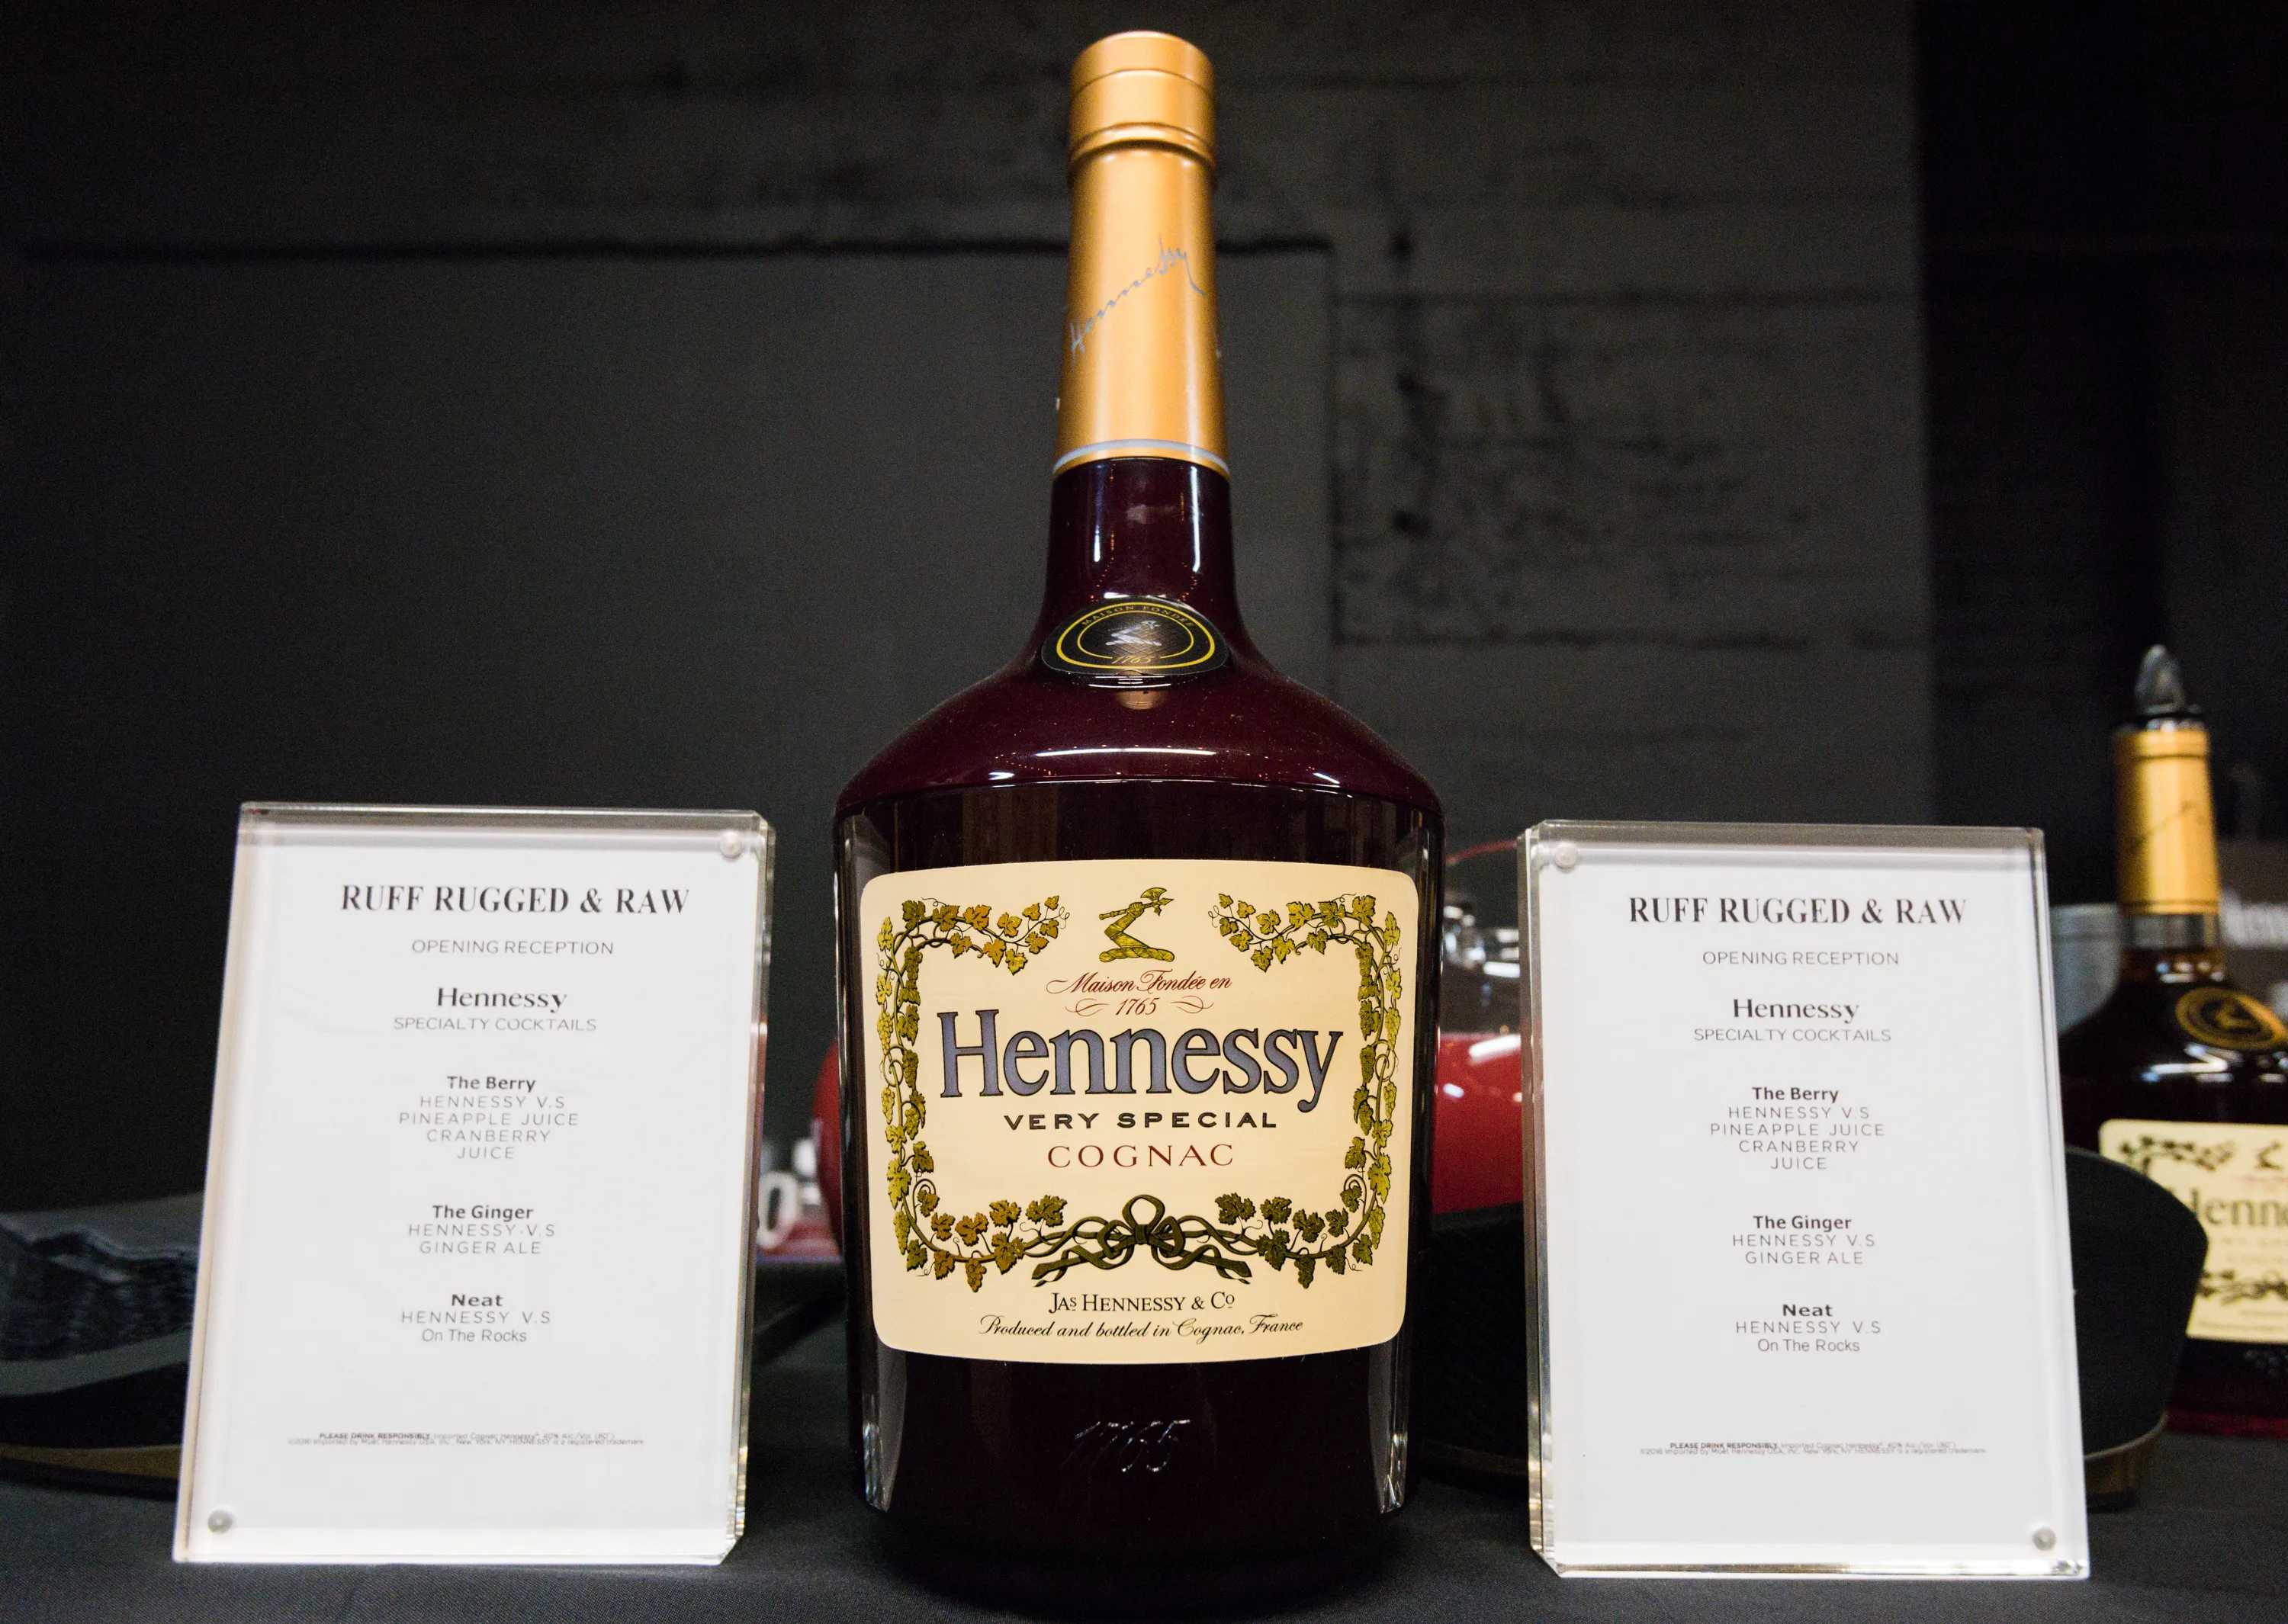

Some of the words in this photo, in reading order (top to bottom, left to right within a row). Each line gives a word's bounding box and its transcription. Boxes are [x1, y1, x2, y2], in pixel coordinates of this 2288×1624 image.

[1081, 605, 1135, 626] MAISON
[1111, 655, 1155, 665] 1765
[342, 885, 424, 911] RUFF
[435, 886, 569, 913] RUGGED
[580, 887, 602, 913] &
[615, 888, 689, 914] RAW
[1629, 897, 1708, 923] RUFF
[1719, 897, 1850, 923] RUGGED
[1861, 898, 1883, 924] &
[1895, 898, 1968, 925] RAW
[411, 939, 499, 954] OPENING
[504, 940, 614, 955] RECEPTION
[1702, 951, 1787, 965] OPENING
[1792, 951, 1899, 965] RECEPTION
[1046, 972, 1136, 993] Maison
[1136, 969, 1206, 993] Fondée
[1210, 978, 1232, 989] en
[437, 987, 567, 1013] Hennessy
[1115, 997, 1158, 1016] 1765
[1733, 998, 1859, 1025] Hennessy
[394, 1017, 490, 1030] SPECIALTY
[495, 1017, 597, 1032] COCKTAILS
[1694, 1029, 1786, 1041] SPECIALTY
[1792, 1029, 1892, 1042] COCKTAILS
[937, 1009, 1344, 1113] Hennessy
[446, 1075, 480, 1090] The
[486, 1076, 536, 1093] Berry
[419, 1095, 527, 1109] HENNESSY
[1751, 1086, 1785, 1101] The
[1790, 1086, 1839, 1104] Berry
[399, 1112, 511, 1126] PINEAPPLE
[521, 1112, 578, 1126] JUICE
[1728, 1106, 1831, 1119] HENNESSY
[1004, 1113, 1099, 1130] VERY
[1117, 1112, 1276, 1128] SPECIAL
[426, 1128, 551, 1143] CRANBERRY
[1710, 1123, 1819, 1136] PINEAPPLE
[1829, 1123, 1885, 1137] JUICE
[457, 1146, 514, 1160] JUICE
[1738, 1140, 1859, 1153] CRANBERRY
[1048, 1144, 1232, 1167] COGNAC
[1770, 1157, 1827, 1170] JUICE
[432, 1204, 466, 1219] The
[471, 1205, 534, 1223] Ginger
[408, 1223, 516, 1237] HENNESSY
[1753, 1215, 1786, 1230] The
[1791, 1215, 1852, 1233] Ginger
[419, 1240, 496, 1254] GINGER
[503, 1240, 541, 1254] ALE
[1732, 1234, 1837, 1247] HENNESSY
[1745, 1250, 1820, 1265] GINGER
[1827, 1251, 1863, 1265] ALE
[451, 1294, 503, 1307] Neat
[1083, 1294, 1185, 1311] HENNESSY
[1191, 1296, 1204, 1310] &
[401, 1311, 510, 1324] HENNESSY
[1782, 1304, 1833, 1317] Neat
[979, 1314, 1052, 1336] Produced
[1057, 1322, 1092, 1337] and
[1096, 1322, 1150, 1337] bottled
[1152, 1319, 1171, 1337] in
[1249, 1313, 1303, 1334] France
[1736, 1320, 1840, 1334] HENNESSY
[421, 1327, 443, 1343] On
[448, 1328, 476, 1343] The
[481, 1328, 527, 1343] Rocks
[1757, 1338, 1779, 1353] On
[1782, 1338, 1810, 1353] The
[1815, 1338, 1860, 1352] Rocks
